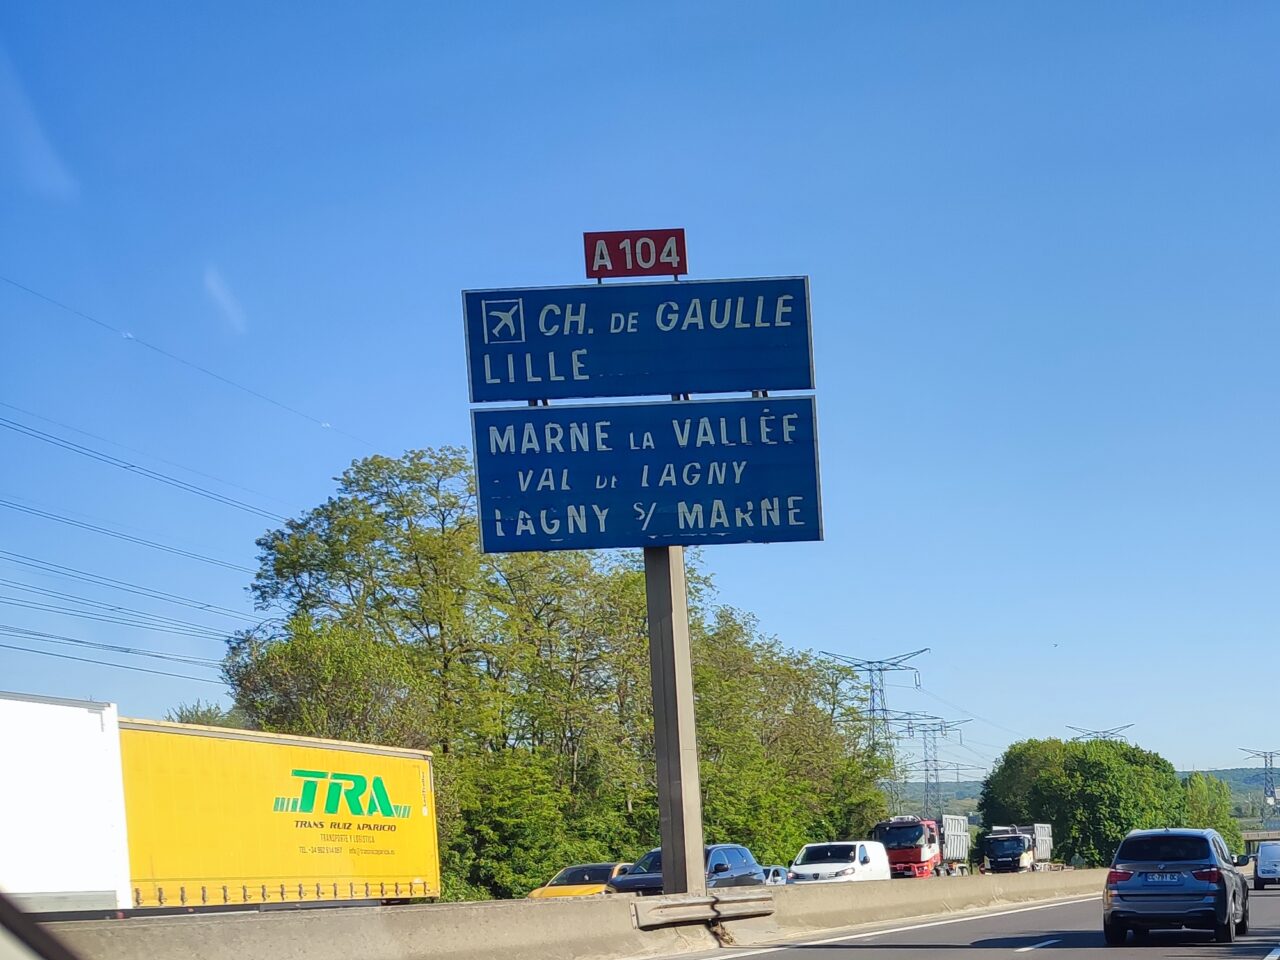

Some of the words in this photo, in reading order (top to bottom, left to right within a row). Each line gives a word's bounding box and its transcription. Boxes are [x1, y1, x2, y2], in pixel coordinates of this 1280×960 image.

[538, 303, 594, 336] CH.
[610, 312, 639, 334] DE
[655, 294, 794, 333] GAULLE
[483, 349, 590, 385] LILLE
[489, 421, 613, 455] MARNE
[629, 431, 655, 451] LA
[517, 467, 572, 493] VAL
[641, 460, 748, 488] LAGNY
[494, 503, 610, 538] LAGNY
[678, 495, 806, 530] MARNE
[291, 768, 396, 818] TRA
[295, 820, 325, 829] TRANS
[330, 822, 352, 830] RUIZ
[356, 823, 397, 832] APARICIO
